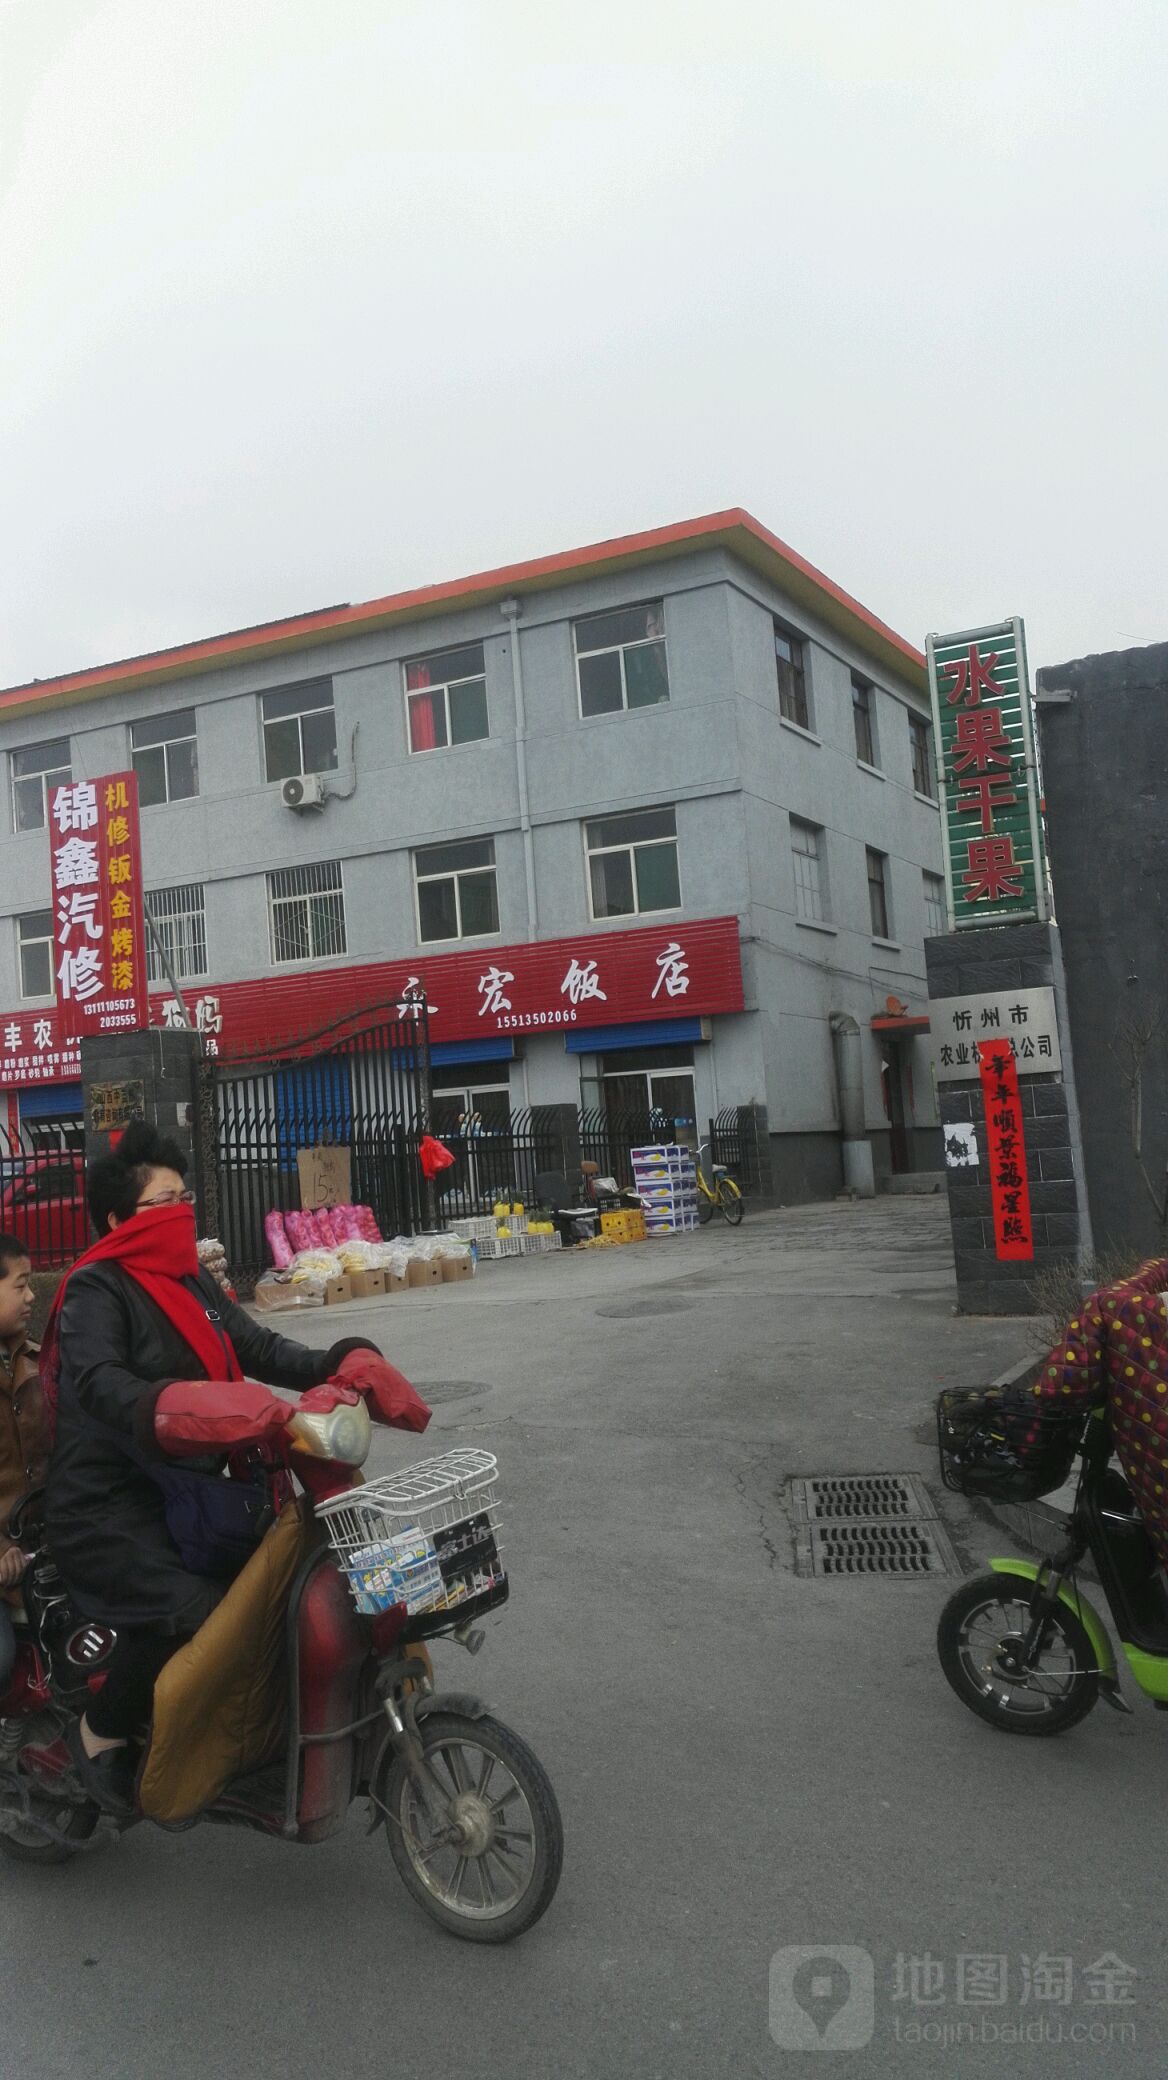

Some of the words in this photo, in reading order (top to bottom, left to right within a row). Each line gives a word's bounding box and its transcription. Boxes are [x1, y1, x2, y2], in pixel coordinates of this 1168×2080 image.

[943, 644, 1025, 903] 水果干果
[52, 782, 105, 1001] 锦鑫汽修
[104, 780, 135, 992] 机修钣金烤漆
[83, 998, 137, 1016] 13111105673
[99, 1013, 137, 1028] 2033555
[496, 1009, 578, 1029] 15513502066
[952, 1003, 1030, 1031] 忻州市
[940, 1034, 1052, 1066] 农业总公司
